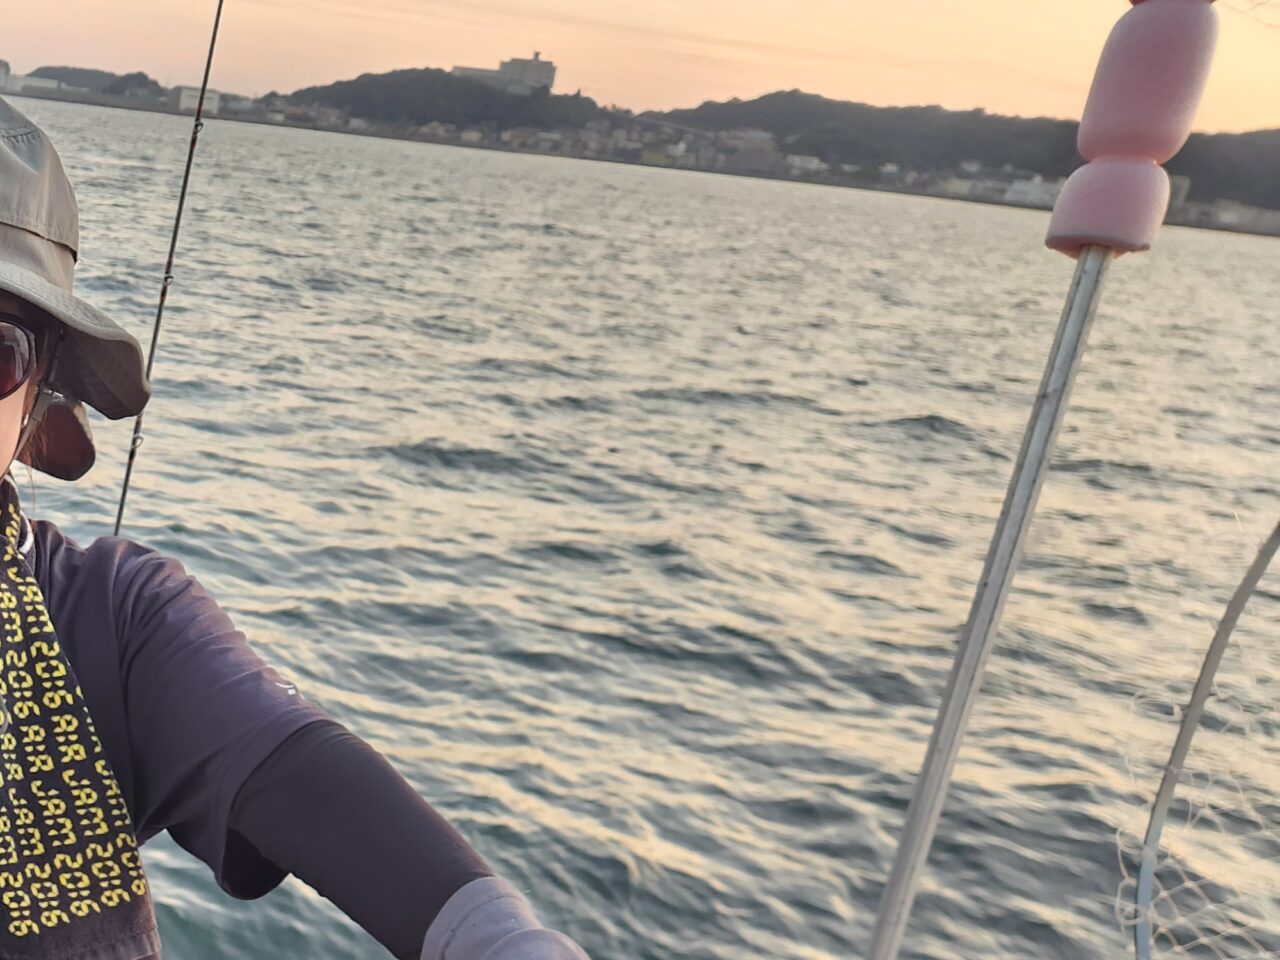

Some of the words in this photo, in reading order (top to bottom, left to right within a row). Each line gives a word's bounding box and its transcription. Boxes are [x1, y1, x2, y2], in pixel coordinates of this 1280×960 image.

[5, 650, 41, 719] 2016
[30, 641, 74, 709] 2016
[0, 732, 24, 781] AIR
[20, 725, 54, 773] AIR
[51, 714, 87, 763] AIR
[8, 787, 45, 856] JAM
[31, 780, 77, 847] JAM
[62, 769, 109, 836] JAM
[25, 862, 70, 927] 2016
[54, 853, 101, 917] 2016
[86, 842, 131, 907] 2016
